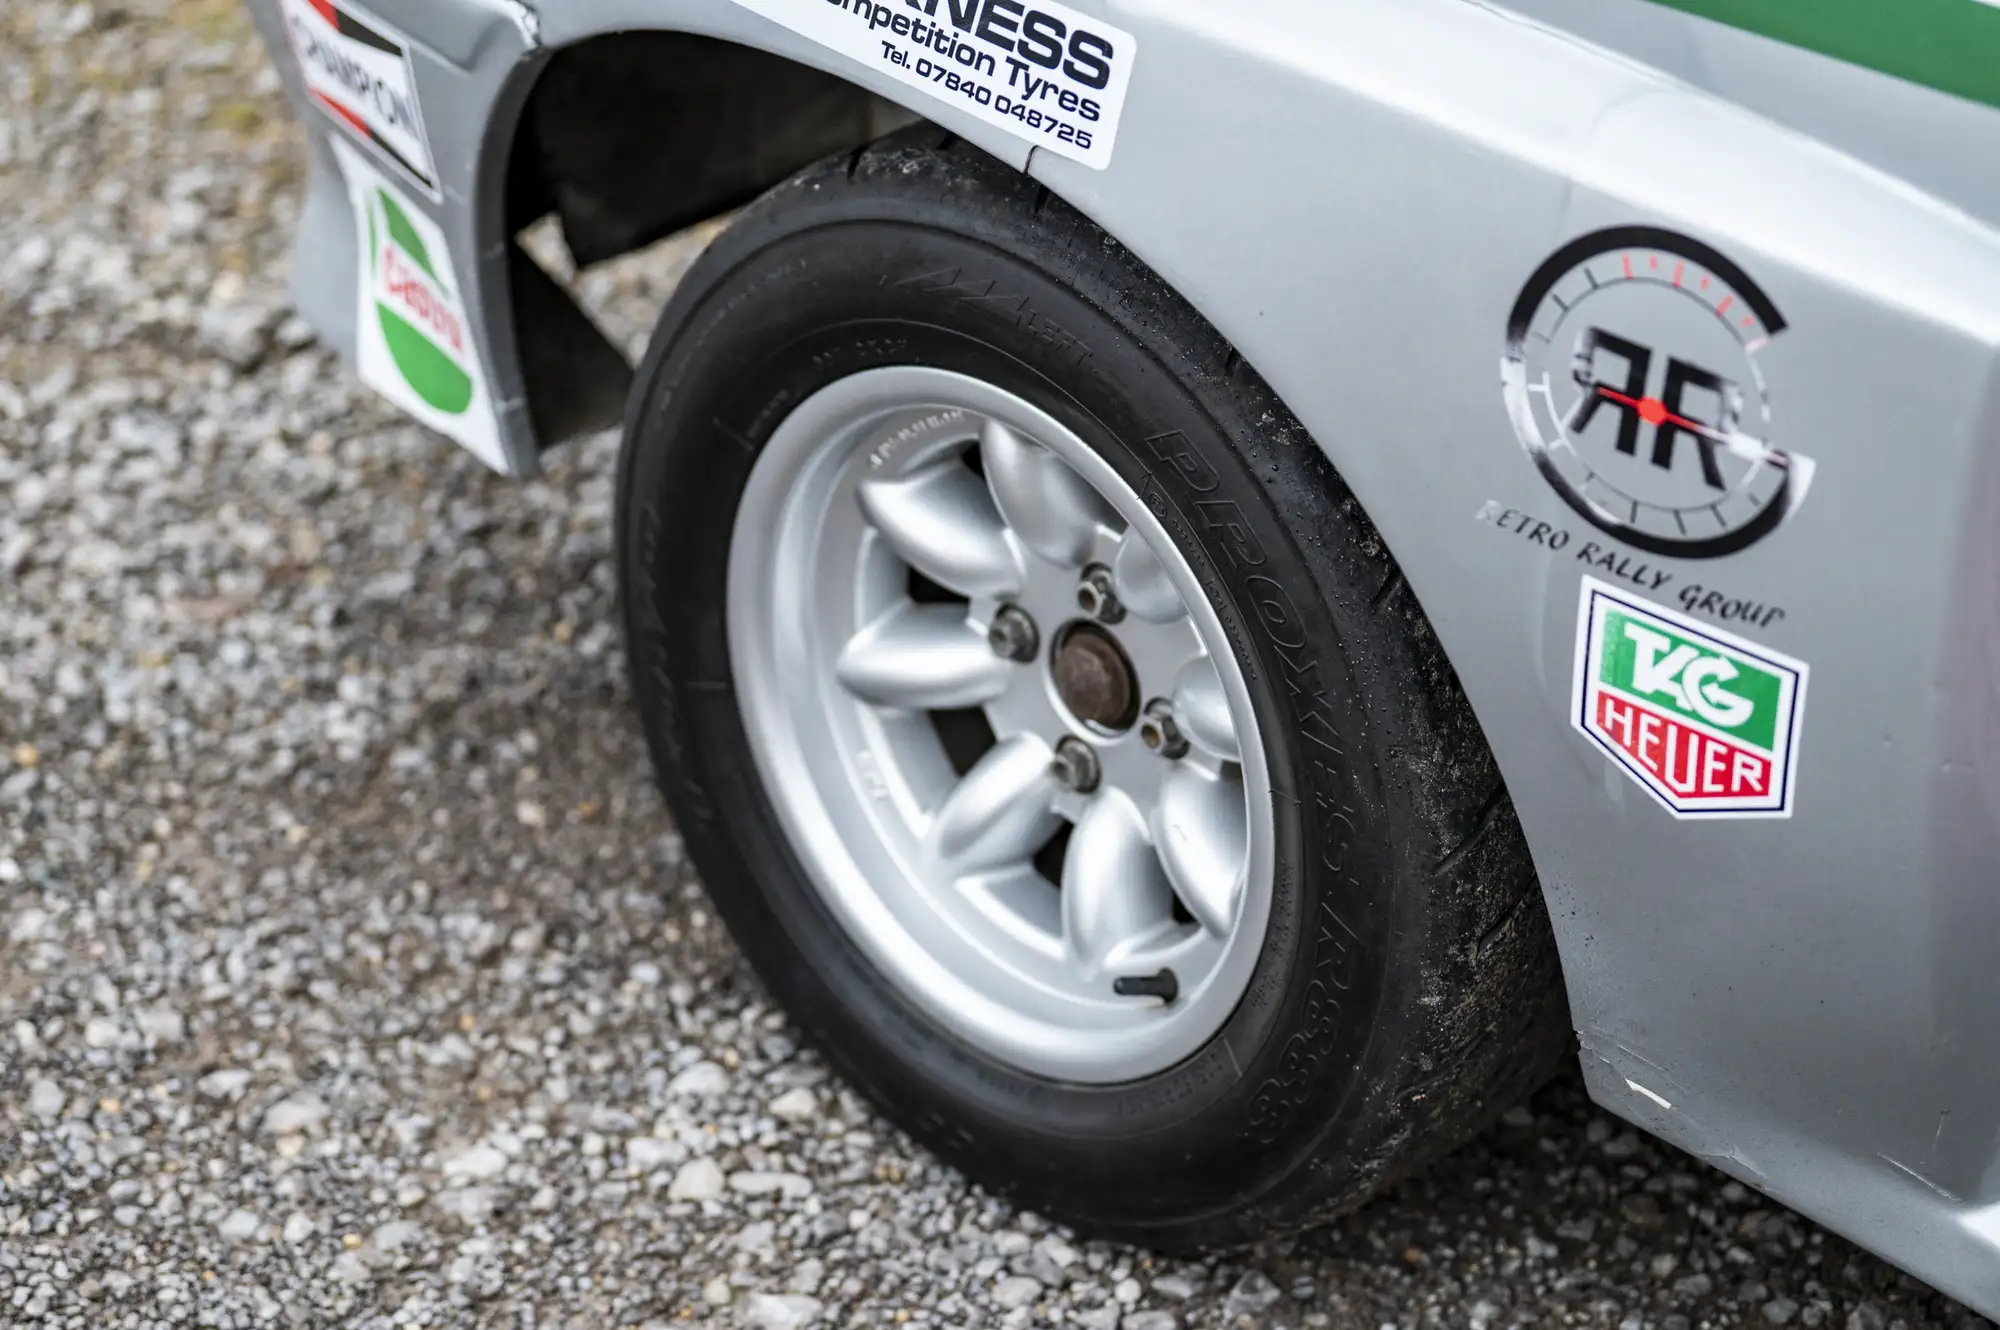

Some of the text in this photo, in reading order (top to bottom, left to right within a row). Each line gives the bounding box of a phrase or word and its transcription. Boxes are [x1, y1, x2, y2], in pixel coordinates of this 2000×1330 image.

[826, 0, 1101, 122] mpetition Tyres
[881, 40, 1093, 150] Tel. 07840 048725
[904, 0, 1114, 90] NESS
[1476, 499, 1786, 628] RETRO RALLY GROUP
[1624, 621, 1754, 727] TAG
[1604, 697, 1764, 794] HEUER
